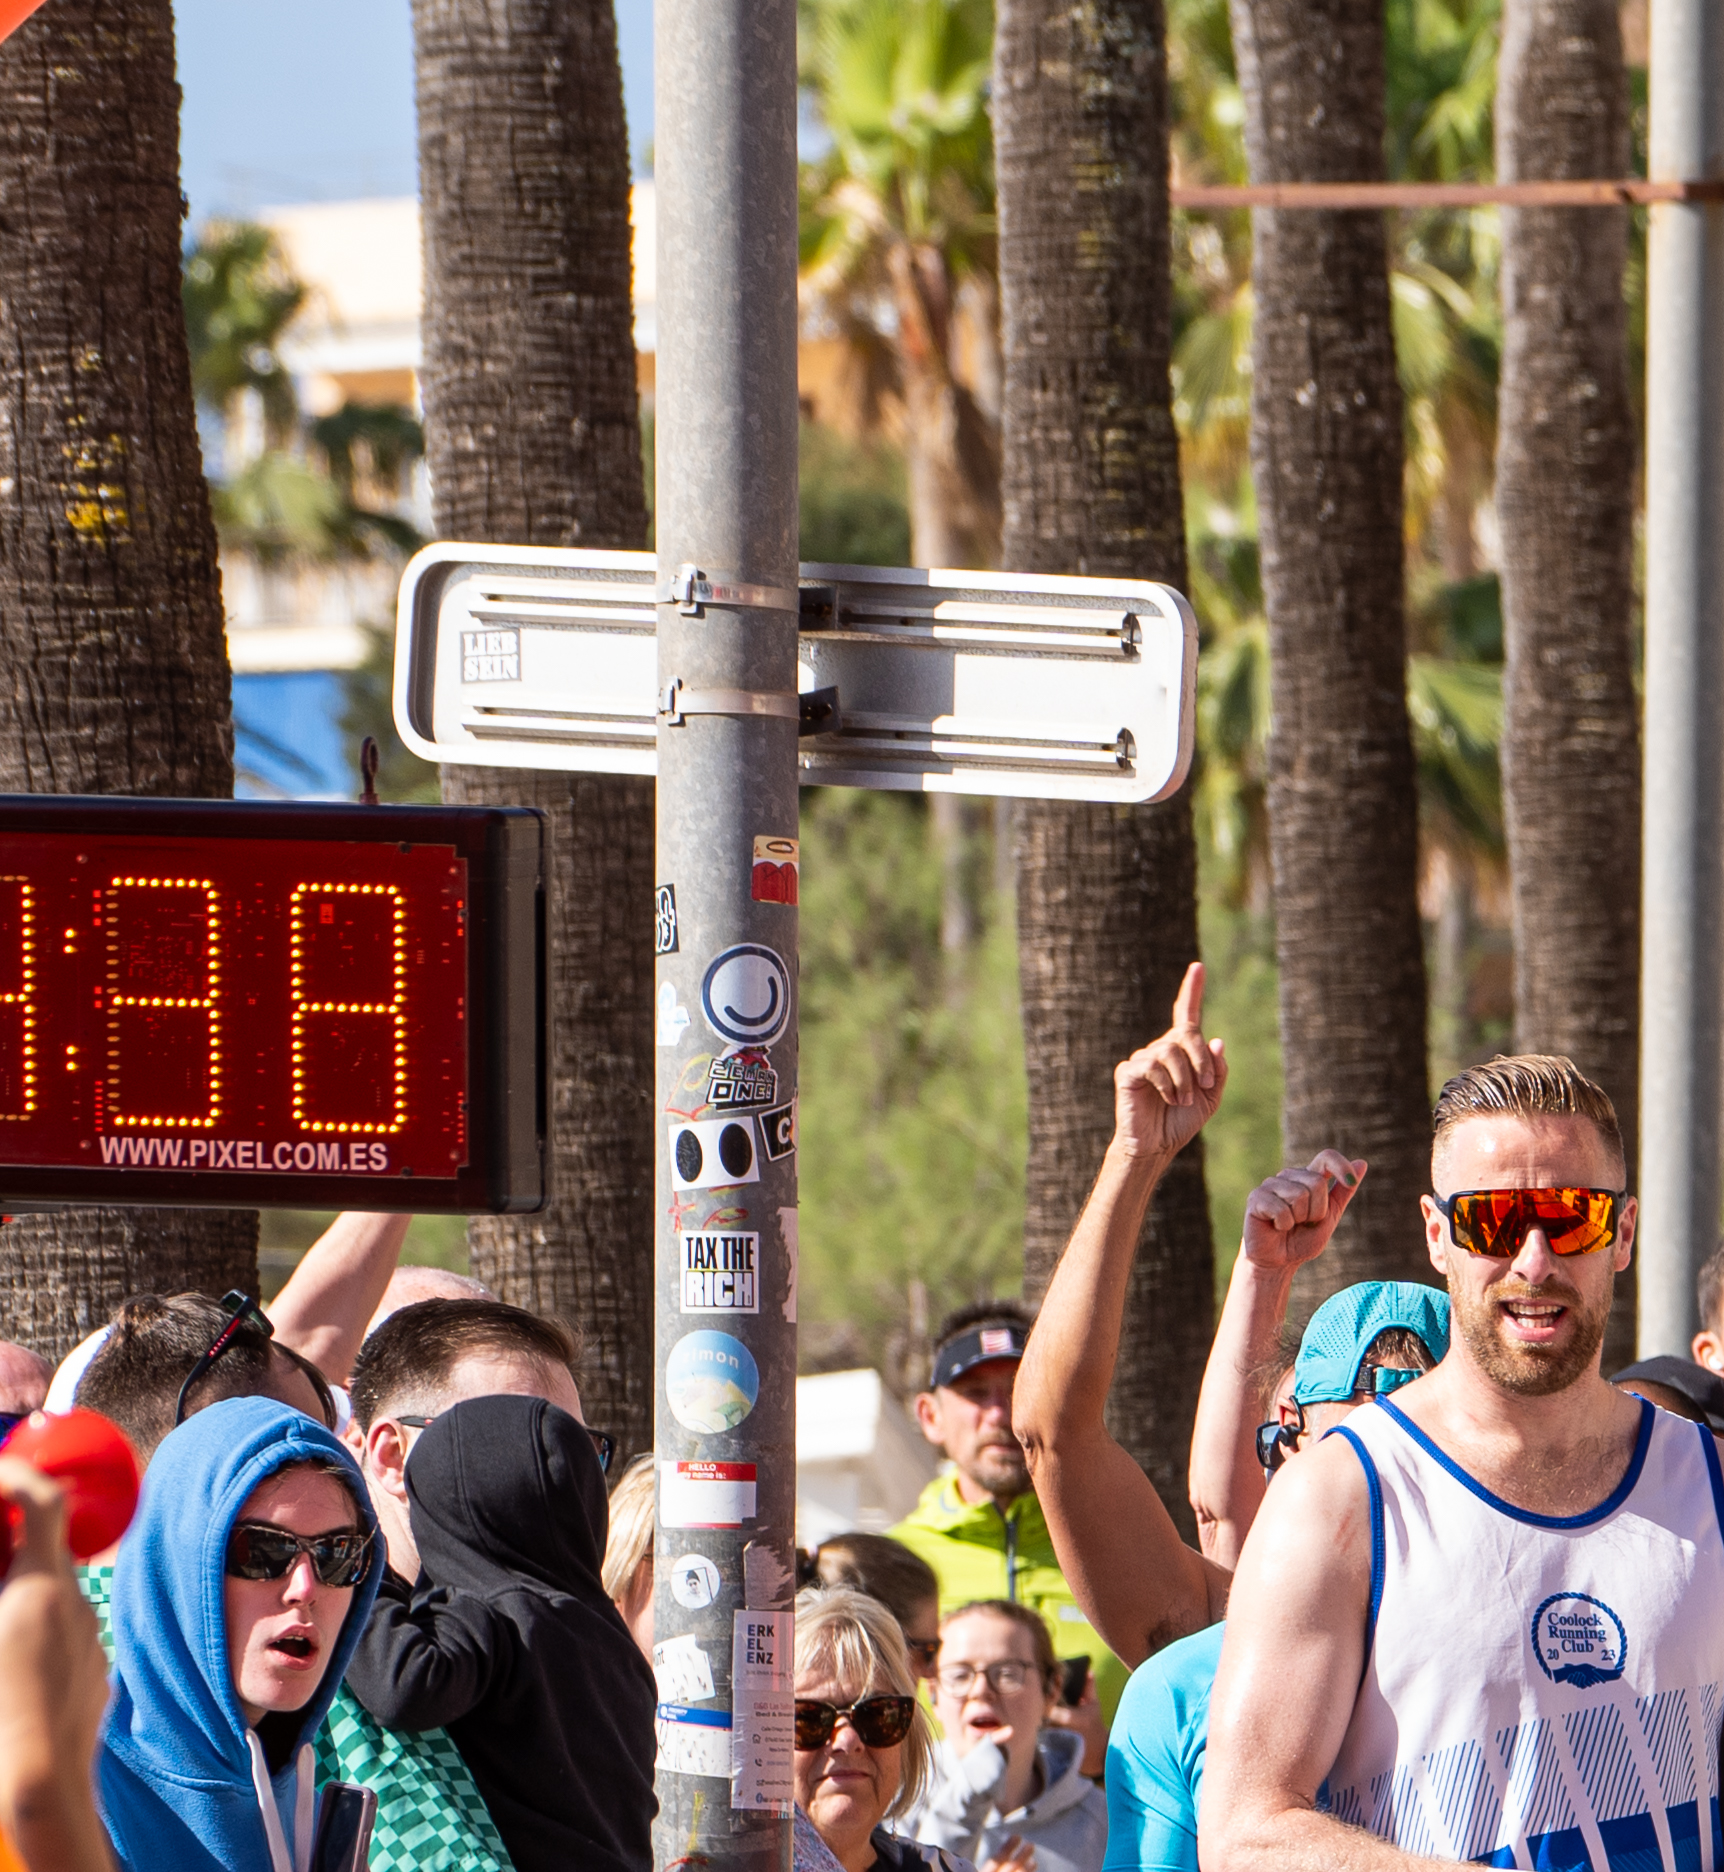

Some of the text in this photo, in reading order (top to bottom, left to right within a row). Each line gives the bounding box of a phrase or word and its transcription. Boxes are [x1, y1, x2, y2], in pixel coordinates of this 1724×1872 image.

[464, 654, 519, 681] SEIN
[0, 872, 408, 1134] :38
[100, 1135, 388, 1170] WWW.PIXELCOM.ES
[686, 1237, 754, 1270] TAX THE
[686, 1271, 753, 1307] RICH
[688, 1463, 716, 1471] HELLO
[1547, 1612, 1603, 1626] Coolock
[747, 1624, 775, 1637] ERK
[1548, 1625, 1607, 1642] Running
[747, 1638, 764, 1650] EL
[1561, 1639, 1594, 1653] Club
[747, 1652, 774, 1665] ENZ
[1547, 1648, 1616, 1661] 20 23
